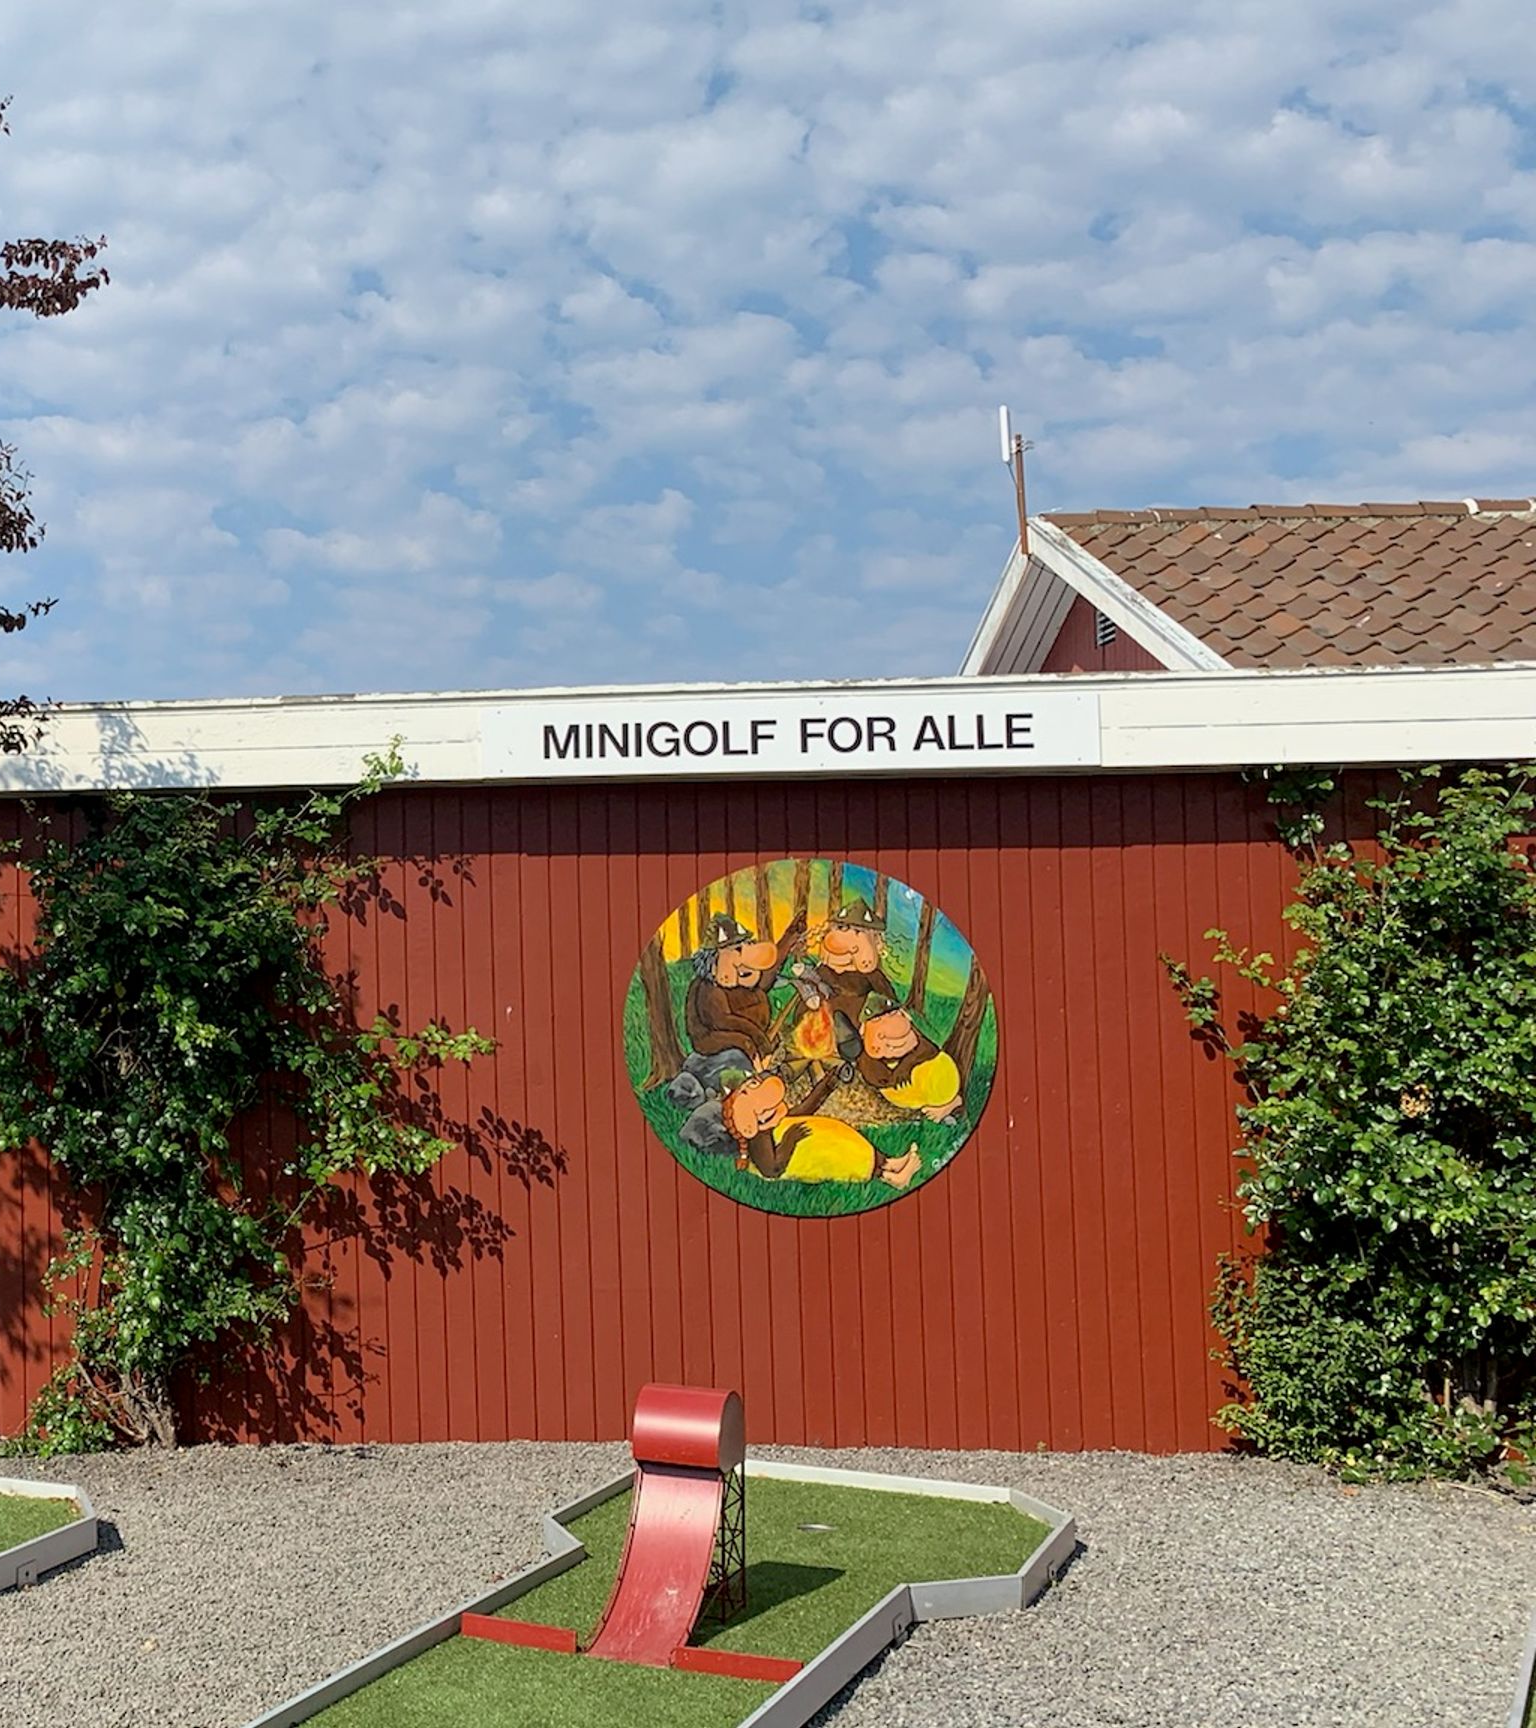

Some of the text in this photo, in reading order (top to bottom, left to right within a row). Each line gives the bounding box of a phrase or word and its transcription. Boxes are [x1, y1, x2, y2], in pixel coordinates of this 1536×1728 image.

[543, 713, 1035, 760] MINIGOLF FOR ALLE
